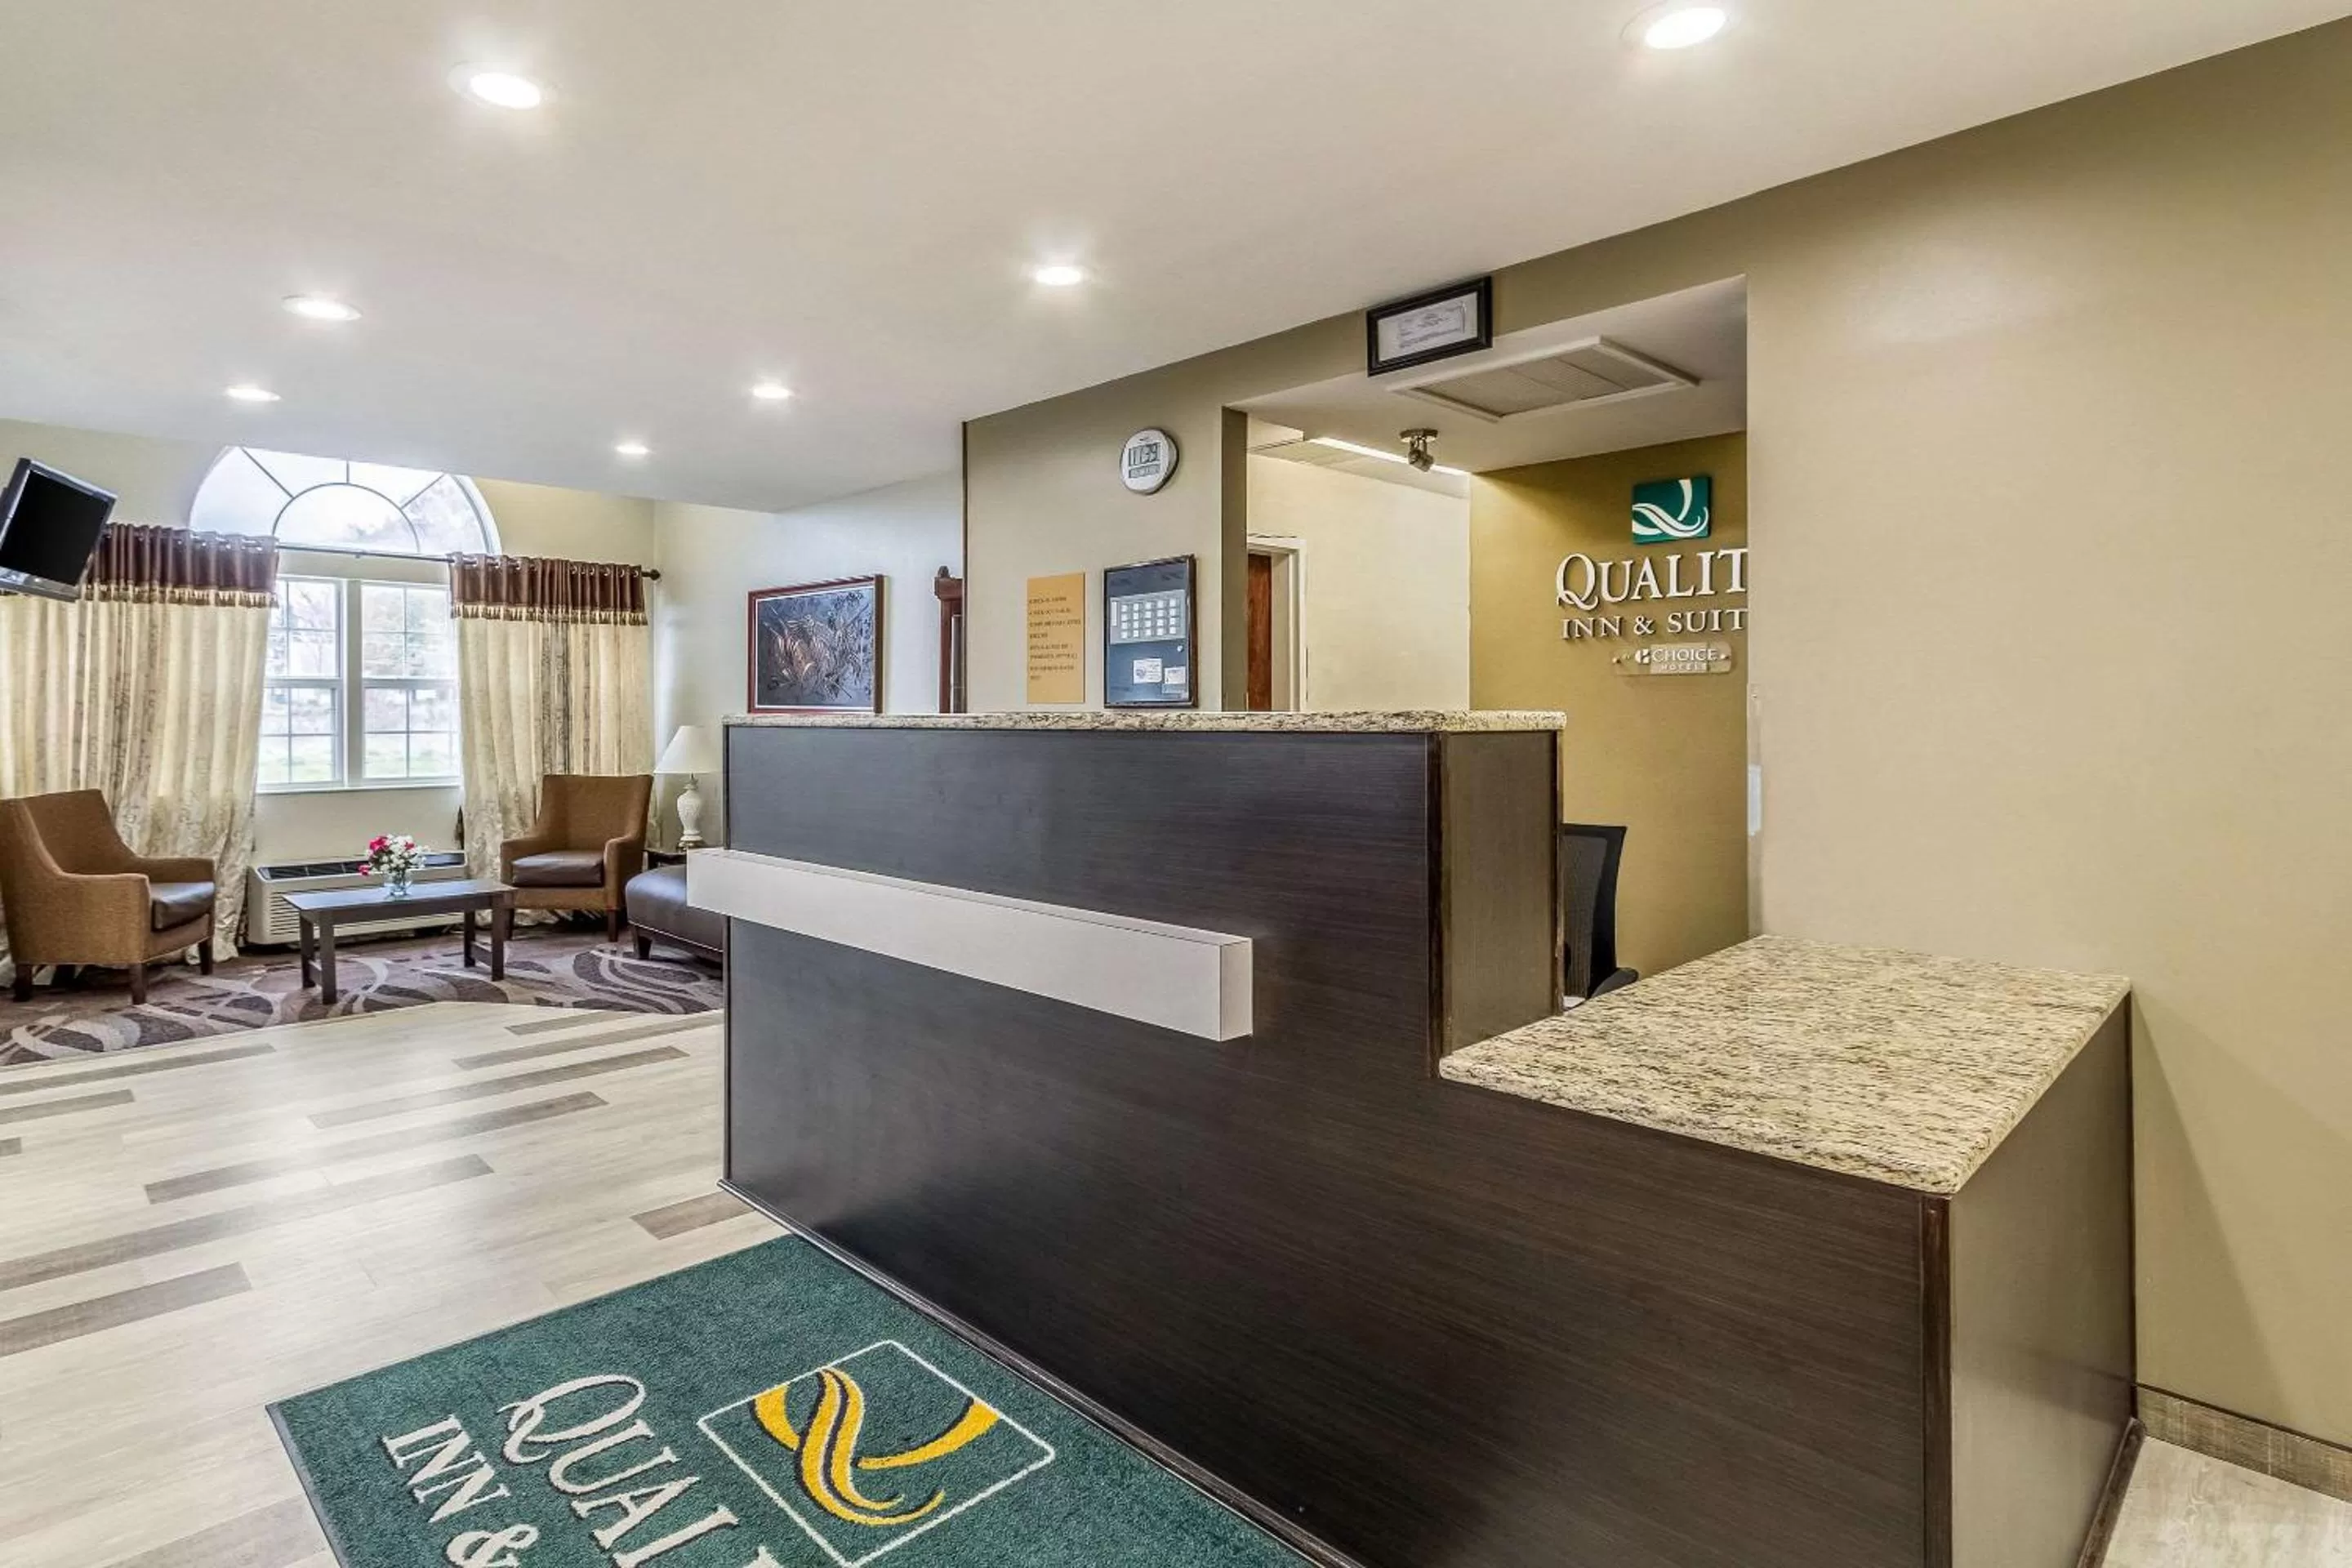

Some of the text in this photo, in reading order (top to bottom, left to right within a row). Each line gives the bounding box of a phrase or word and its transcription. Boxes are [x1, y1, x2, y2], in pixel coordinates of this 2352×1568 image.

[1556, 548, 1748, 611] QUALIT
[1561, 608, 1748, 639] INN & SUIT
[1652, 648, 1717, 662] CHOICE
[382, 1414, 539, 1568] INN &
[497, 1374, 786, 1568] QUAL
